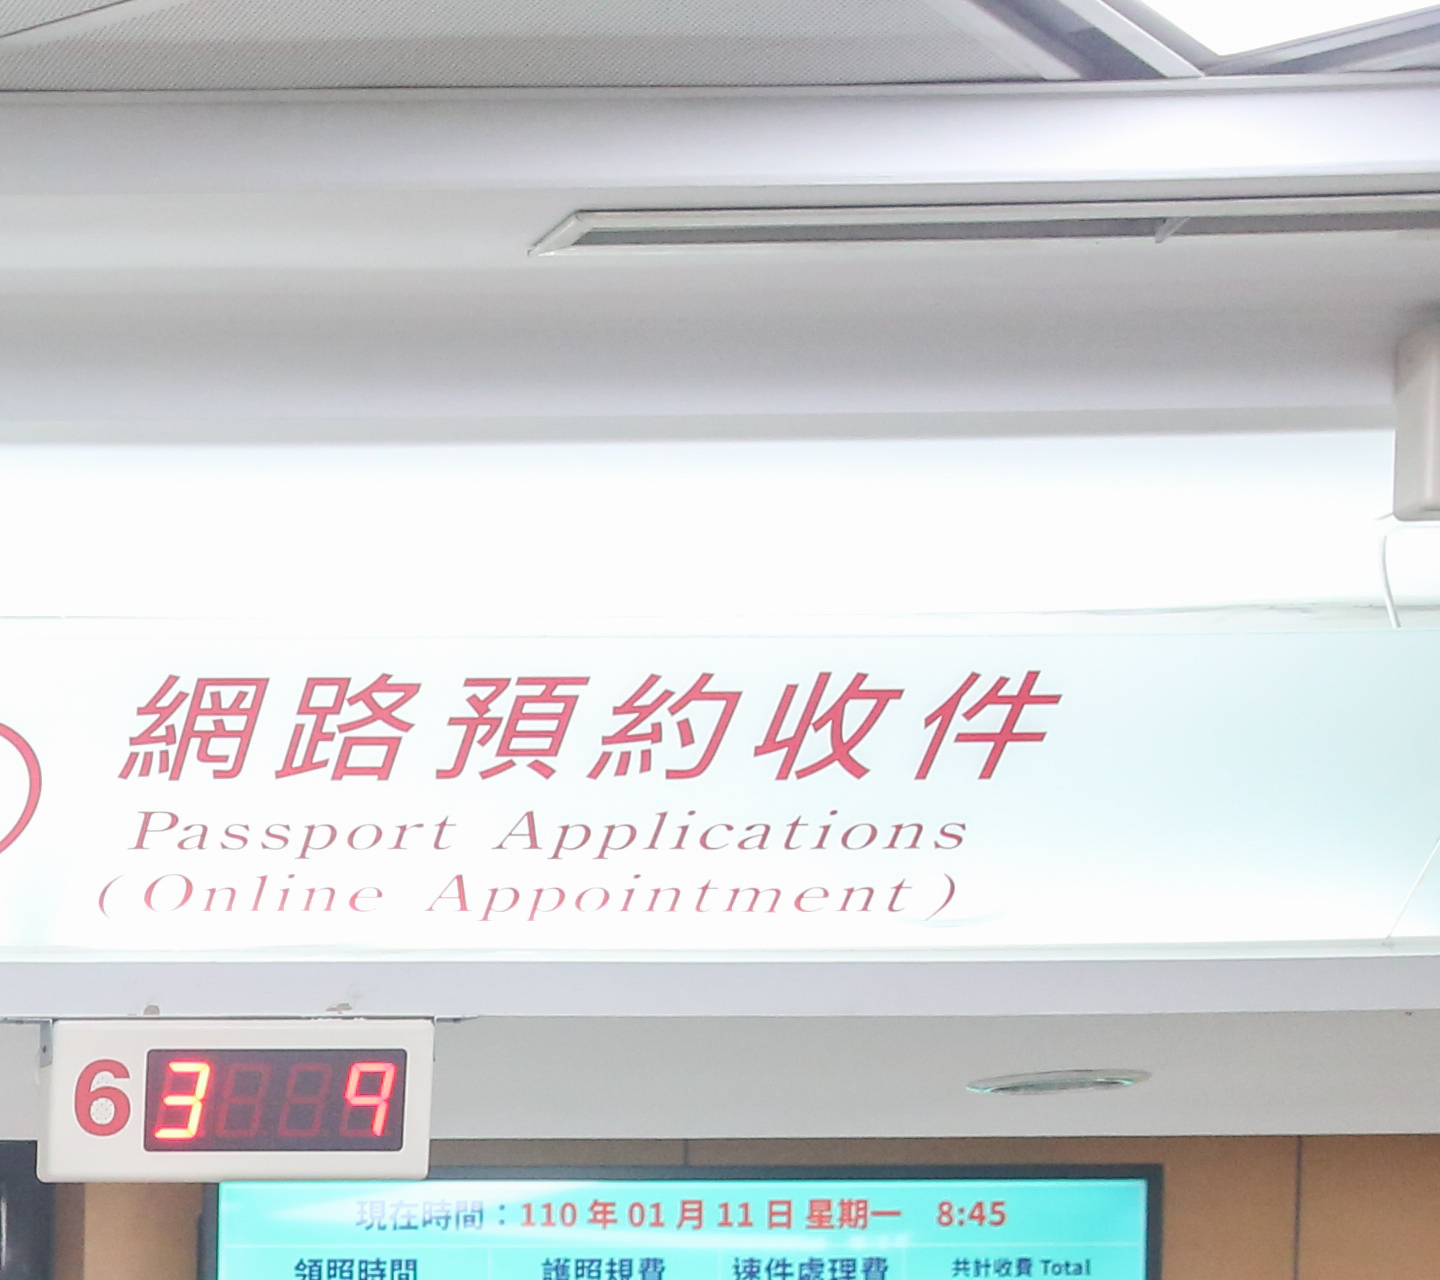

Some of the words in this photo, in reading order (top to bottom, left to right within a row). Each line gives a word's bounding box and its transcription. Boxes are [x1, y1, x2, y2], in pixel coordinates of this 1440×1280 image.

[116, 668, 1063, 785] 網路預約收件
[127, 810, 458, 862] Passport
[489, 806, 969, 858] Applications
[72, 1058, 132, 1137] 6
[521, 1201, 578, 1227] 110
[629, 1201, 666, 1227] 01
[717, 1201, 755, 1227] 11
[805, 1198, 902, 1229] 星期一
[936, 1201, 1008, 1228] 8:45
[951, 1257, 1033, 1278] 共計收費
[1040, 1258, 1092, 1277] Total
